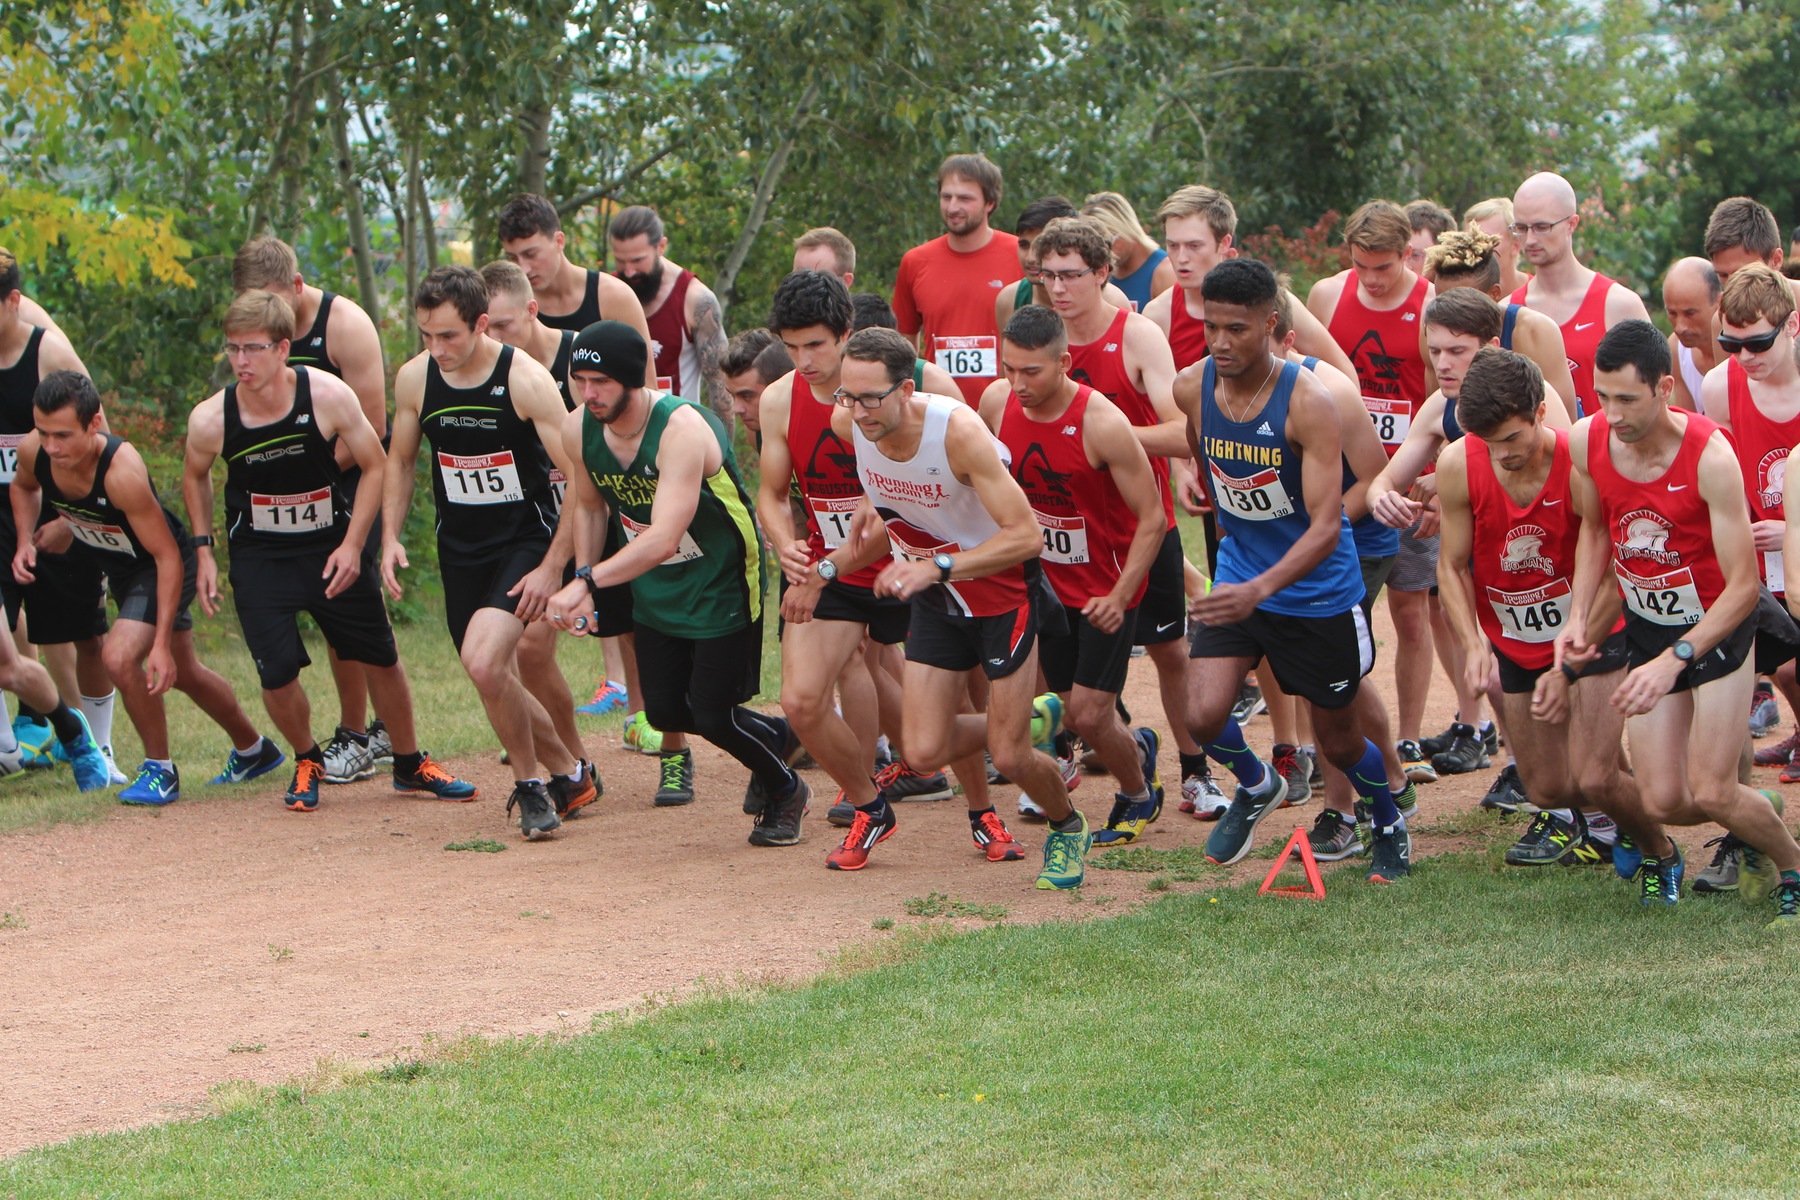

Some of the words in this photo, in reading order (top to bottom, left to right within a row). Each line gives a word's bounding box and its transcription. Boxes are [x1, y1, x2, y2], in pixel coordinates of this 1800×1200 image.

[572, 347, 601, 364] MAYO
[944, 350, 983, 374] 163
[440, 415, 498, 429] RDC
[1256, 429, 1275, 437] adidas
[1204, 436, 1283, 467] LIGHTNING
[453, 468, 505, 495] 115
[807, 482, 865, 496] AUGUSTAN
[873, 472, 934, 497] Running
[503, 493, 519, 501] 115
[879, 492, 916, 504] ATHLETIC
[918, 501, 940, 509] CLUB
[1221, 484, 1272, 512] 130
[267, 503, 318, 525] 114
[832, 500, 861, 512] Runnin
[1271, 508, 1289, 518] 130
[315, 521, 328, 529] 114
[75, 525, 120, 547] 116
[1042, 528, 1071, 554] 40
[683, 551, 698, 560] 154
[1069, 555, 1084, 564] 140
[1615, 541, 1681, 567] TROJANS
[1631, 586, 1685, 616] 142
[1505, 601, 1562, 632] 146
[1682, 614, 1700, 624] 142
